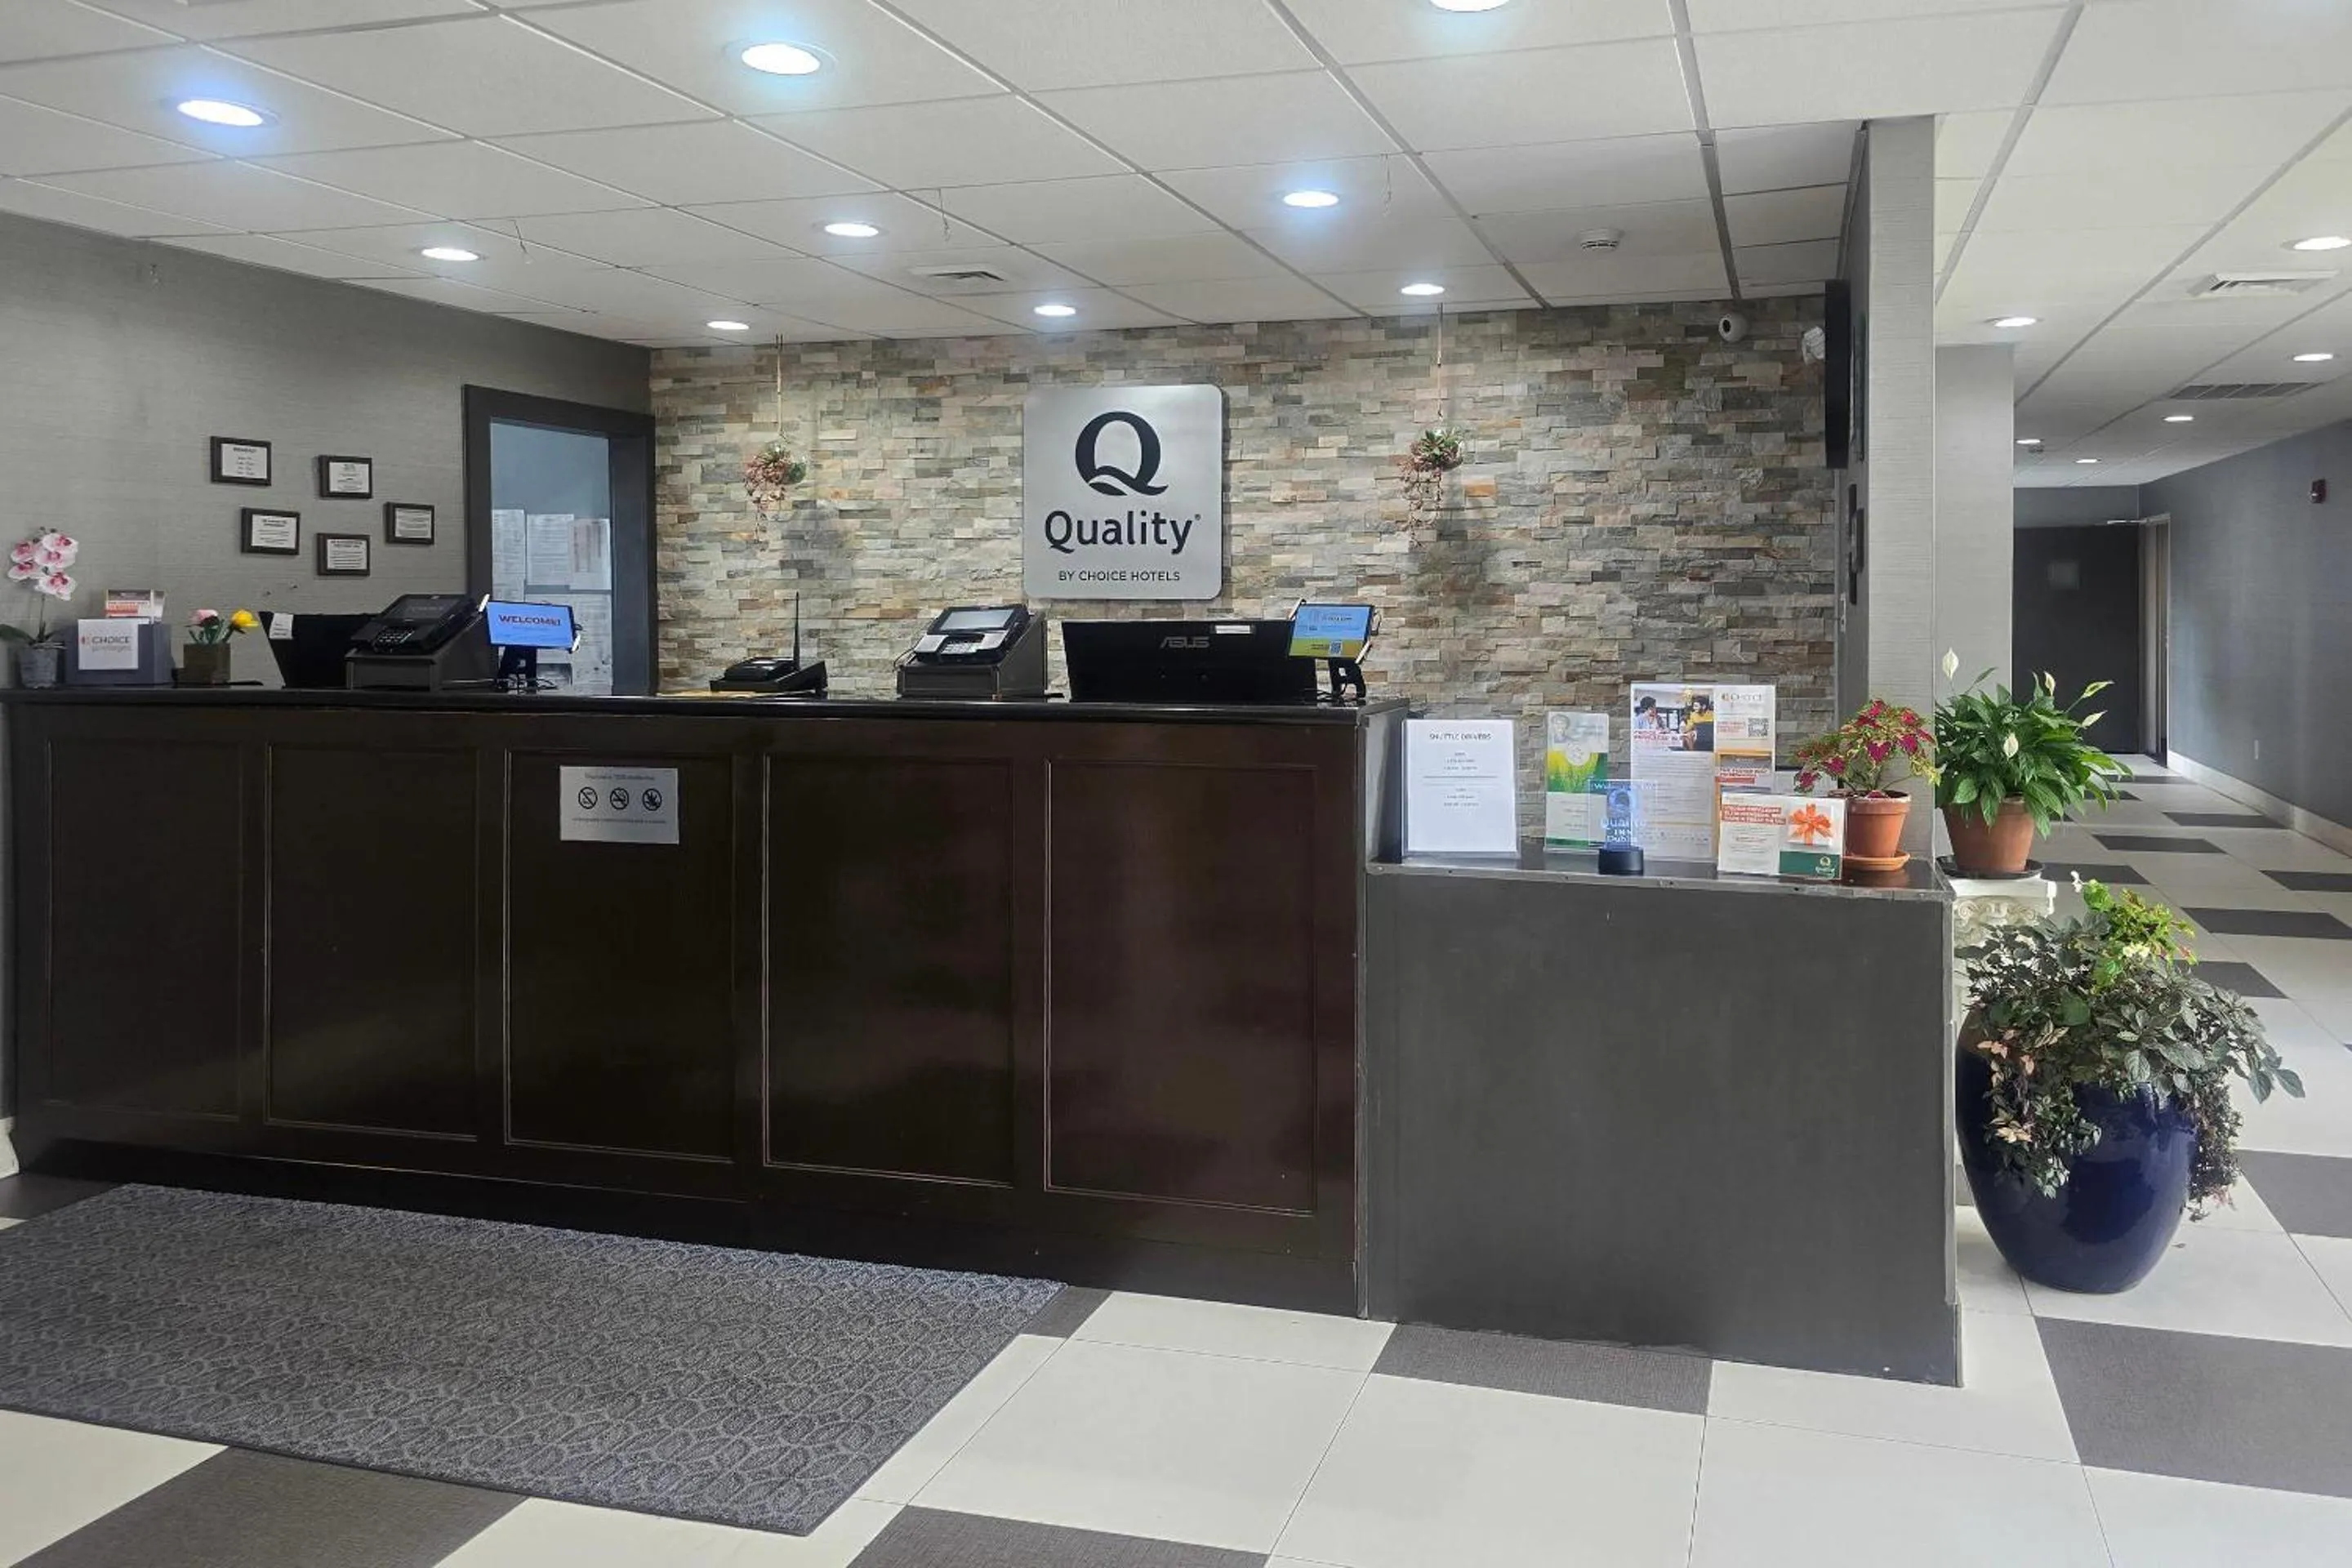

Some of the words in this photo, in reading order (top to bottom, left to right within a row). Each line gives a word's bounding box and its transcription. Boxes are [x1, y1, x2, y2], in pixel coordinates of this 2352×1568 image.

[1076, 411, 1169, 496] Q
[1045, 510, 1193, 555] Quality
[1058, 571, 1074, 581] BY
[1079, 571, 1127, 581] CHOICE
[1131, 571, 1180, 581] HOTELS
[498, 613, 561, 626] WELCOME!
[91, 636, 131, 644] CHOICE
[1160, 636, 1209, 648] ASUS
